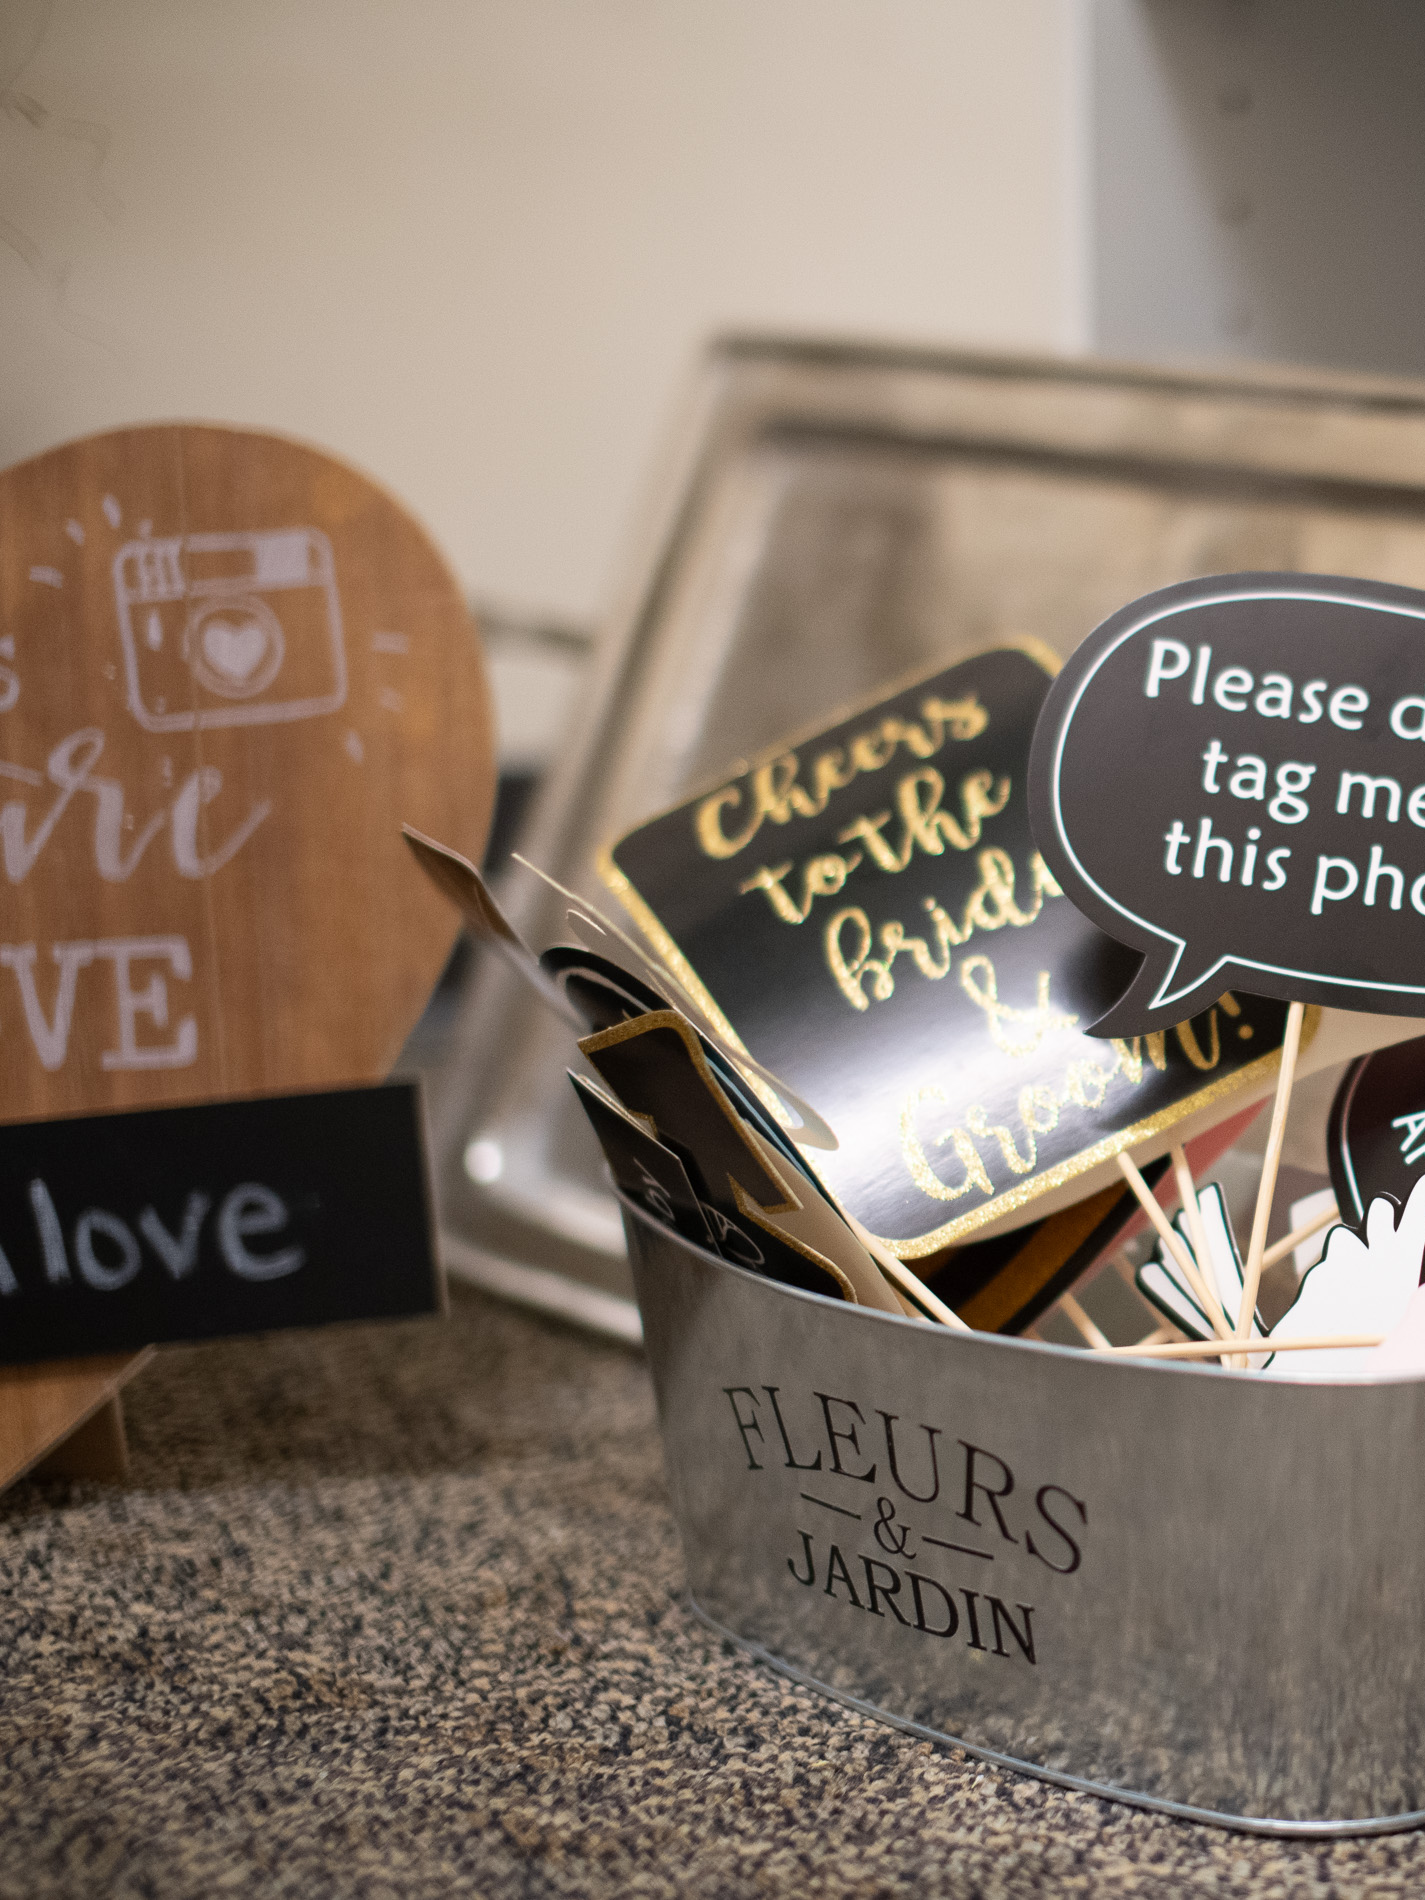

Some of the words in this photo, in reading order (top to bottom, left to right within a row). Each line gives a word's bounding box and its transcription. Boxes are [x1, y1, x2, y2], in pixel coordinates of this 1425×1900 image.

[1145, 638, 1370, 731] Please
[694, 691, 990, 860] Cheers
[1202, 739, 1317, 824] tag
[738, 851, 863, 925] to
[838, 765, 1012, 873] the
[1164, 817, 1293, 891] this
[960, 954, 1080, 1057] &
[29, 1176, 307, 1292] love
[722, 1384, 1089, 1575] FLEURS
[872, 1496, 917, 1561] &
[787, 1529, 1037, 1666] JARDIN
